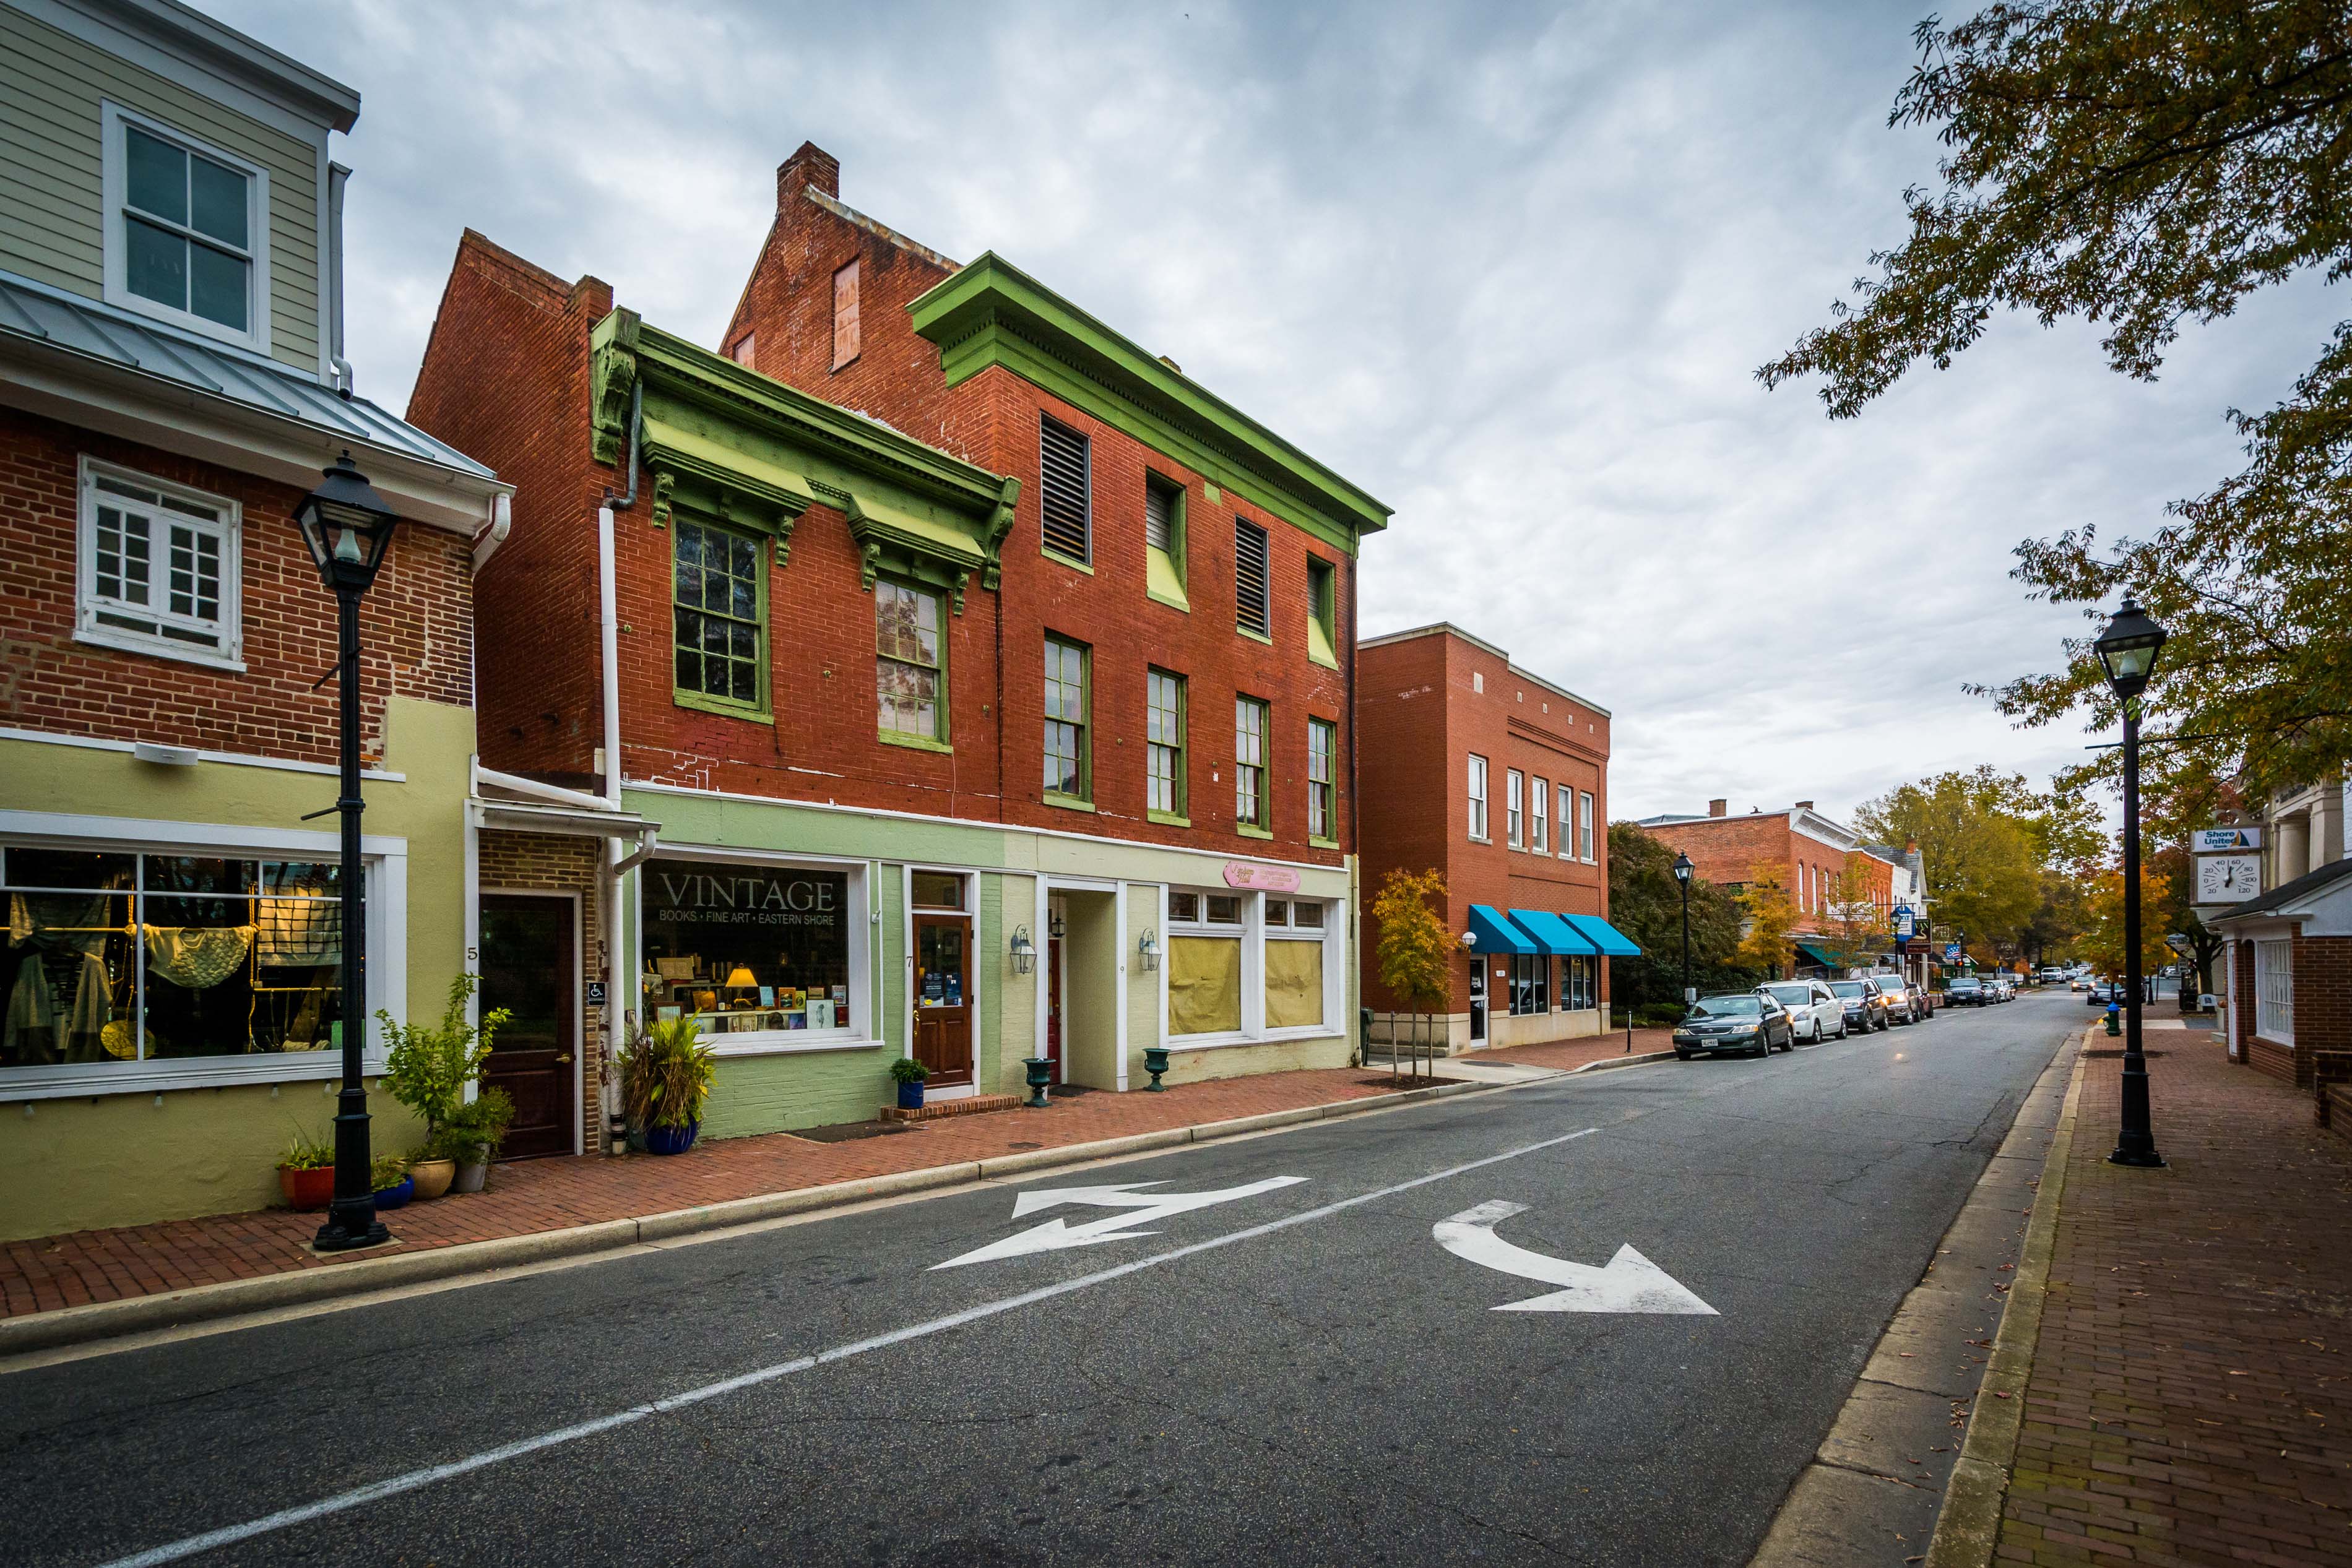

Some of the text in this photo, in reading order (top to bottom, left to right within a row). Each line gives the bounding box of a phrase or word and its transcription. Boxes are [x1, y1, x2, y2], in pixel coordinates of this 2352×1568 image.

[659, 873, 836, 911] VINTAGE
[659, 910, 836, 926] BOOKS FINE ART EASTERN SHORE
[468, 947, 478, 960] 5
[907, 956, 912, 968] 7
[1120, 965, 1125, 974] 9
